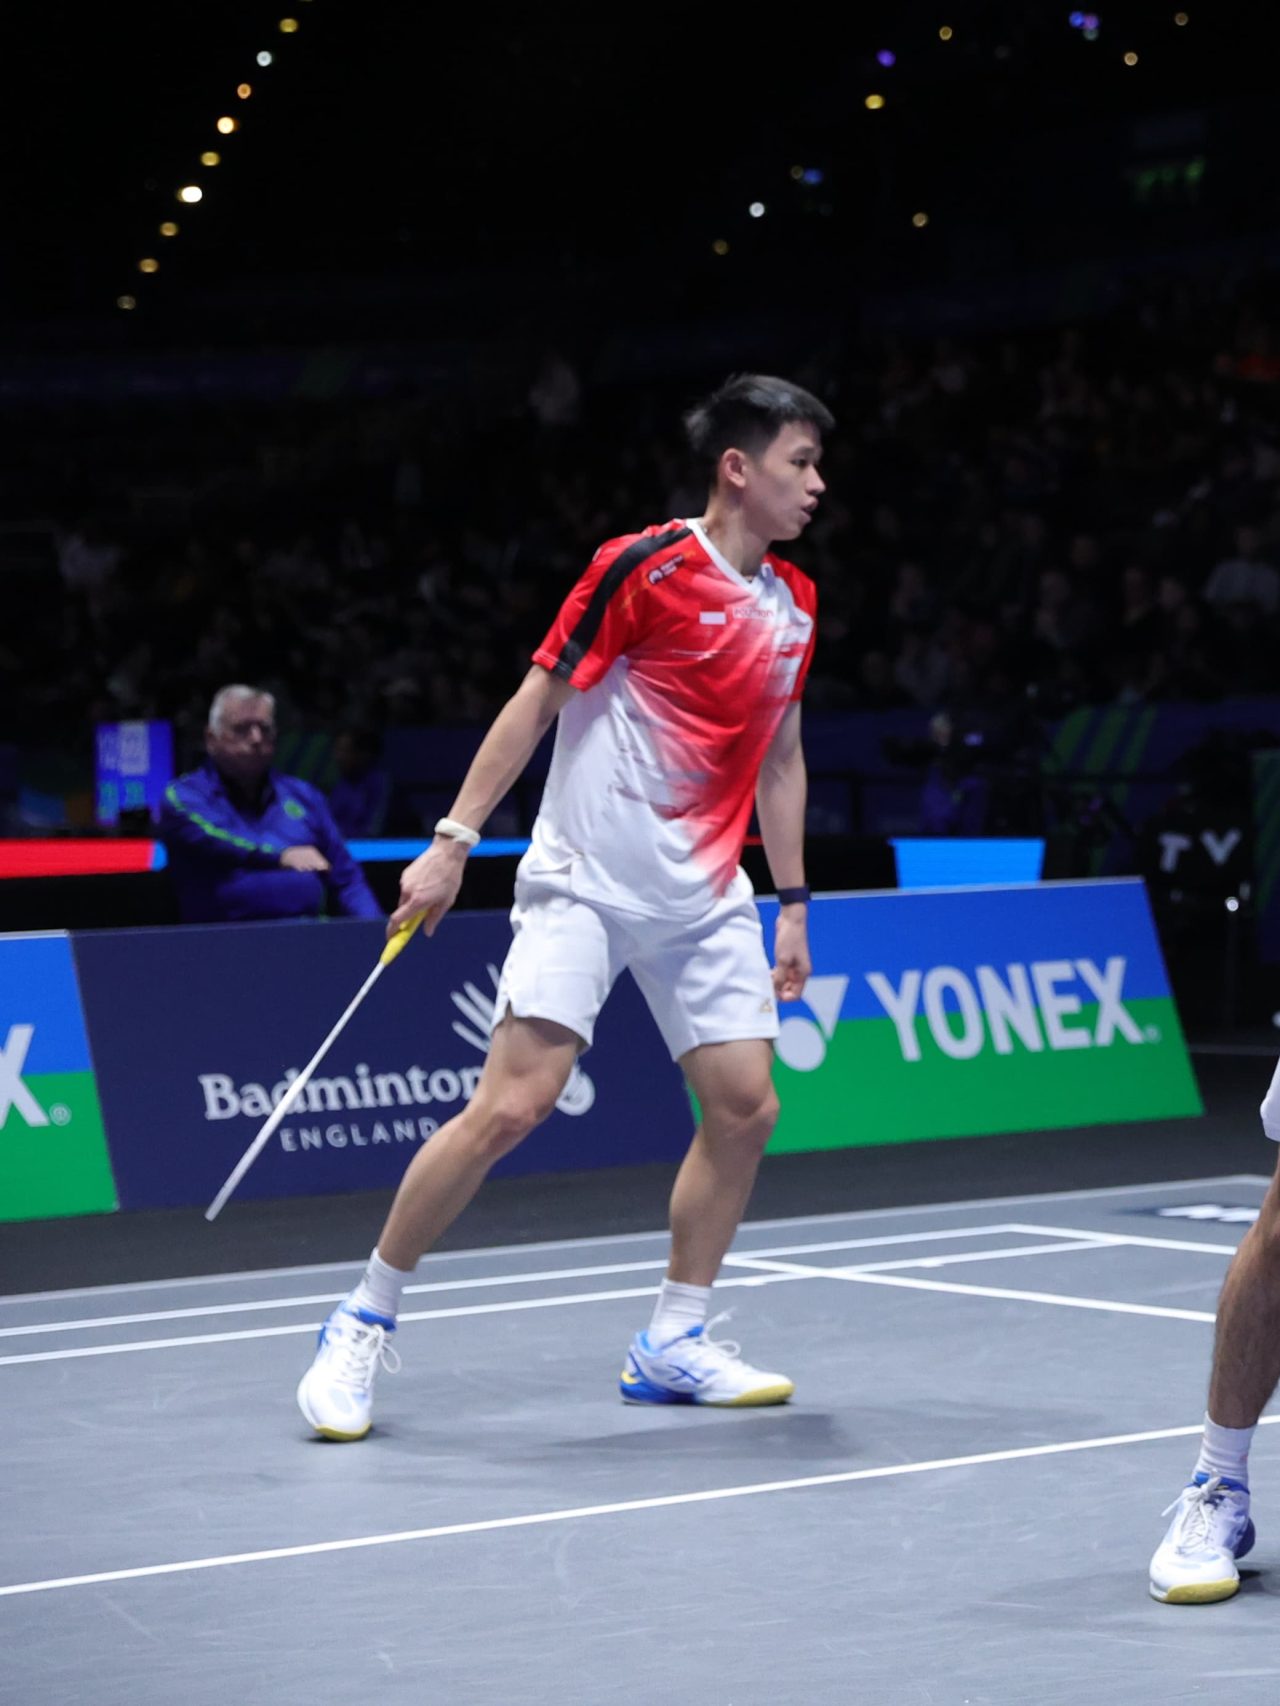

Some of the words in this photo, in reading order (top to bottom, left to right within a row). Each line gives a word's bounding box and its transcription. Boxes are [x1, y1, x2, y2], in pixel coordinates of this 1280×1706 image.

[1157, 826, 1244, 875] TV
[864, 956, 1146, 1062] YONEX
[279, 1116, 440, 1152] ENGLAND
